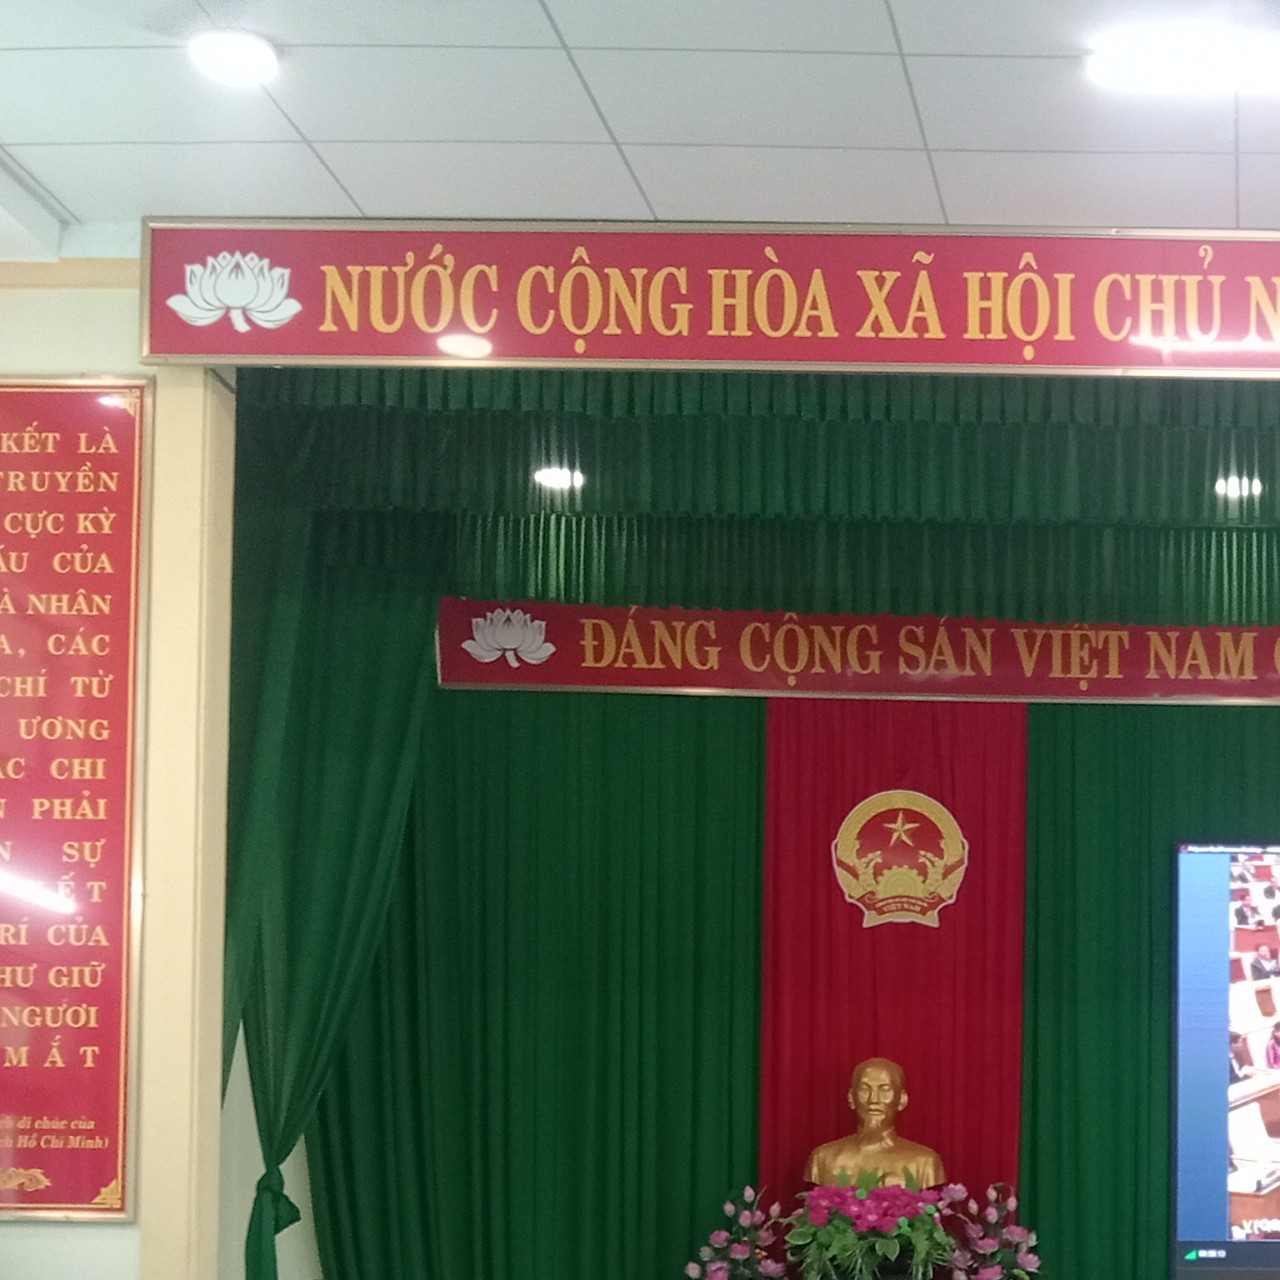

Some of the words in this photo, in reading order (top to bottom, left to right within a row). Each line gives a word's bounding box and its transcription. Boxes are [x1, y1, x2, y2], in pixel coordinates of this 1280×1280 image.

[317, 242, 499, 333] NƯỚC
[517, 246, 693, 354] CỘNG
[707, 245, 839, 338] HÒA
[855, 250, 947, 341] XÃ
[963, 252, 1076, 361] HỘI
[1097, 245, 1221, 346] CHỦ
[0, 421, 60, 453] KẾT
[78, 426, 119, 453] LÀ
[0, 461, 119, 493] RUYỀN
[4, 510, 64, 538] CỰC
[76, 506, 116, 534] KỲ
[53, 544, 114, 574] CỦA
[26, 589, 112, 615] NHÂN
[47, 627, 110, 656] CÁC
[739, 613, 881, 686] CỘNG
[1010, 623, 1129, 691] VIỆT
[1146, 630, 1256, 681] NAM
[70, 669, 114, 698] TỪ
[18, 715, 110, 741] ƯƠNG
[50, 757, 107, 780] CHI
[32, 790, 108, 820] PHẢI
[62, 839, 105, 868] SỰ
[47, 916, 110, 946] CỦA
[48, 961, 105, 988] GIỮ
